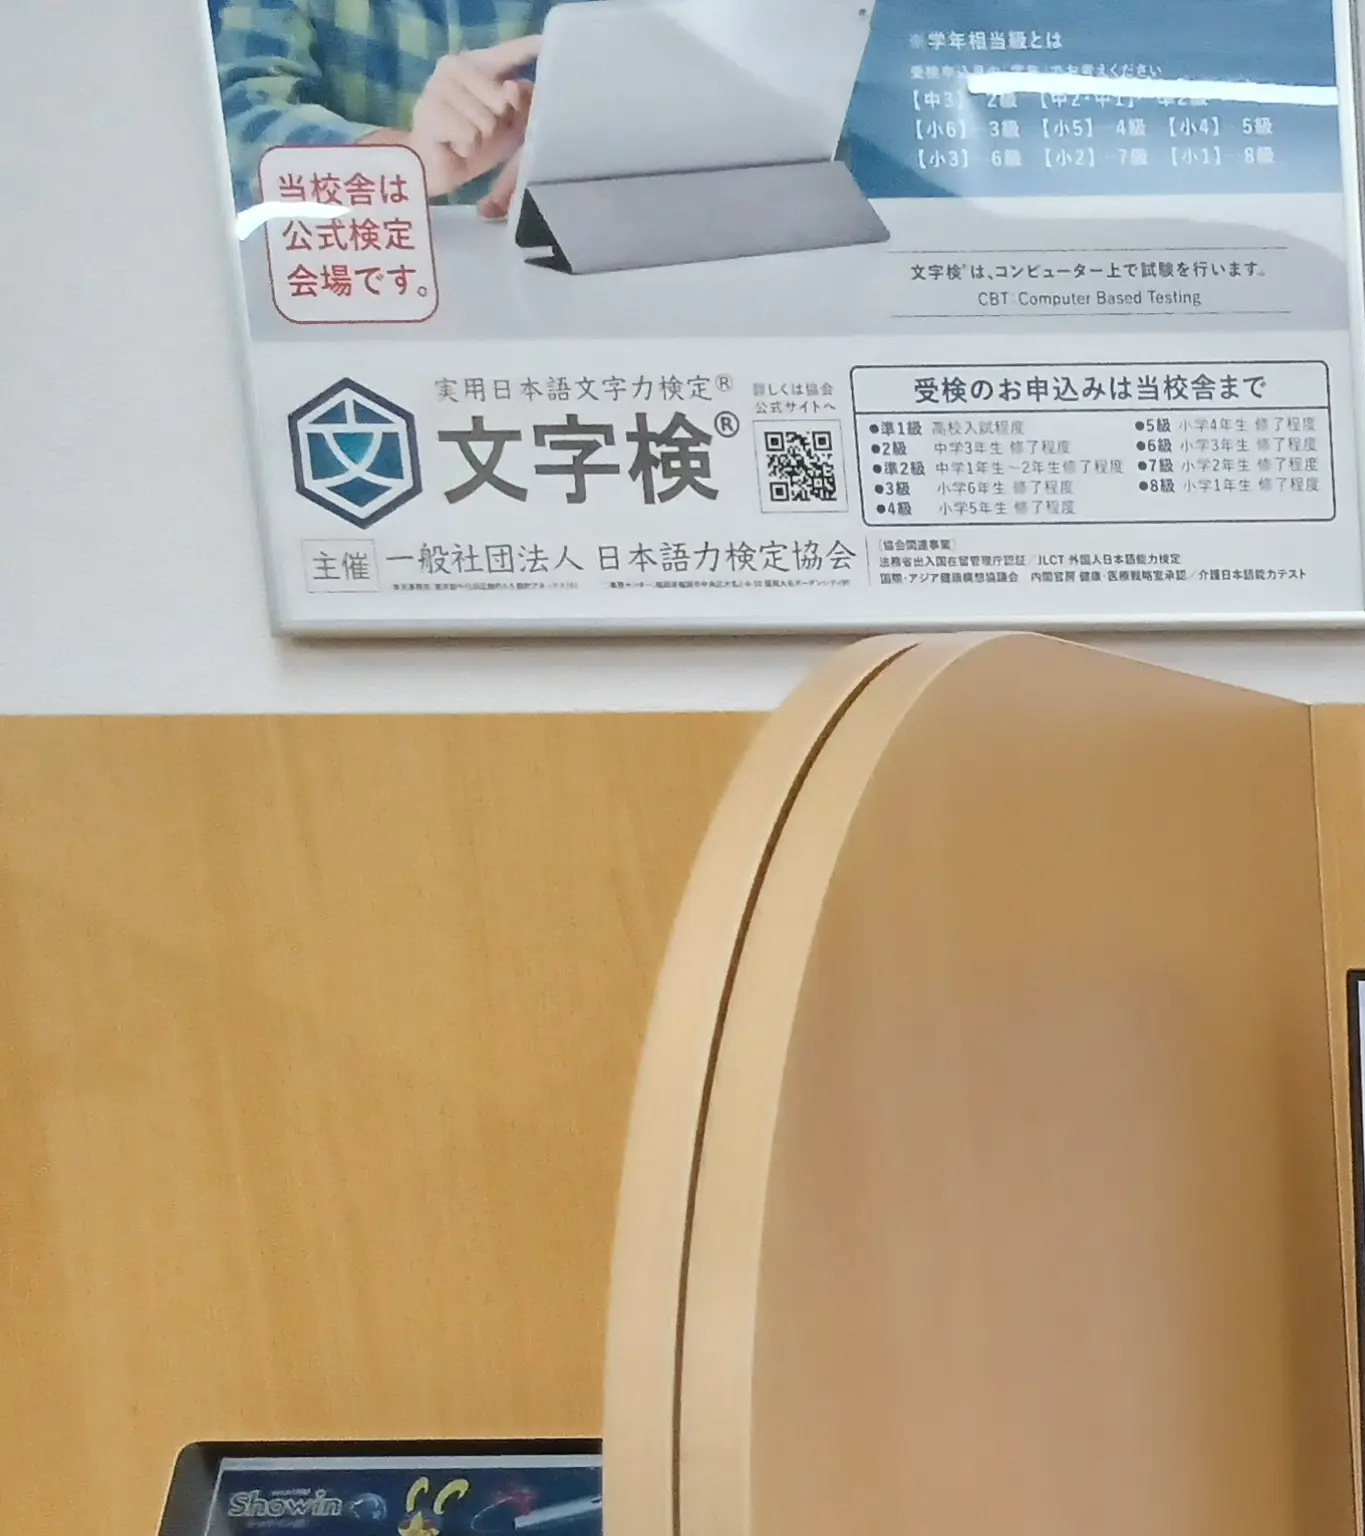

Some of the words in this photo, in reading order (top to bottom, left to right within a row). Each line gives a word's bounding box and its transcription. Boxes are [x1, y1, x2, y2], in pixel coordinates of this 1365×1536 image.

[279, 172, 408, 206] 当校舎は
[281, 217, 415, 253] 公式検定
[287, 263, 428, 299] 会場です。
[1018, 290, 1091, 308] Computer
[1096, 290, 1143, 305] Based
[1147, 289, 1202, 307] Testing
[914, 374, 1267, 404] 受検のお申込みは当校舎まで
[755, 400, 836, 415] 公式サイトへ
[932, 421, 1025, 436] 高校入試程度
[312, 551, 371, 582] 主催
[385, 543, 584, 575] 一般社団法人
[599, 539, 857, 574] 日本語力検定協会
[228, 1489, 343, 1517] Showin
